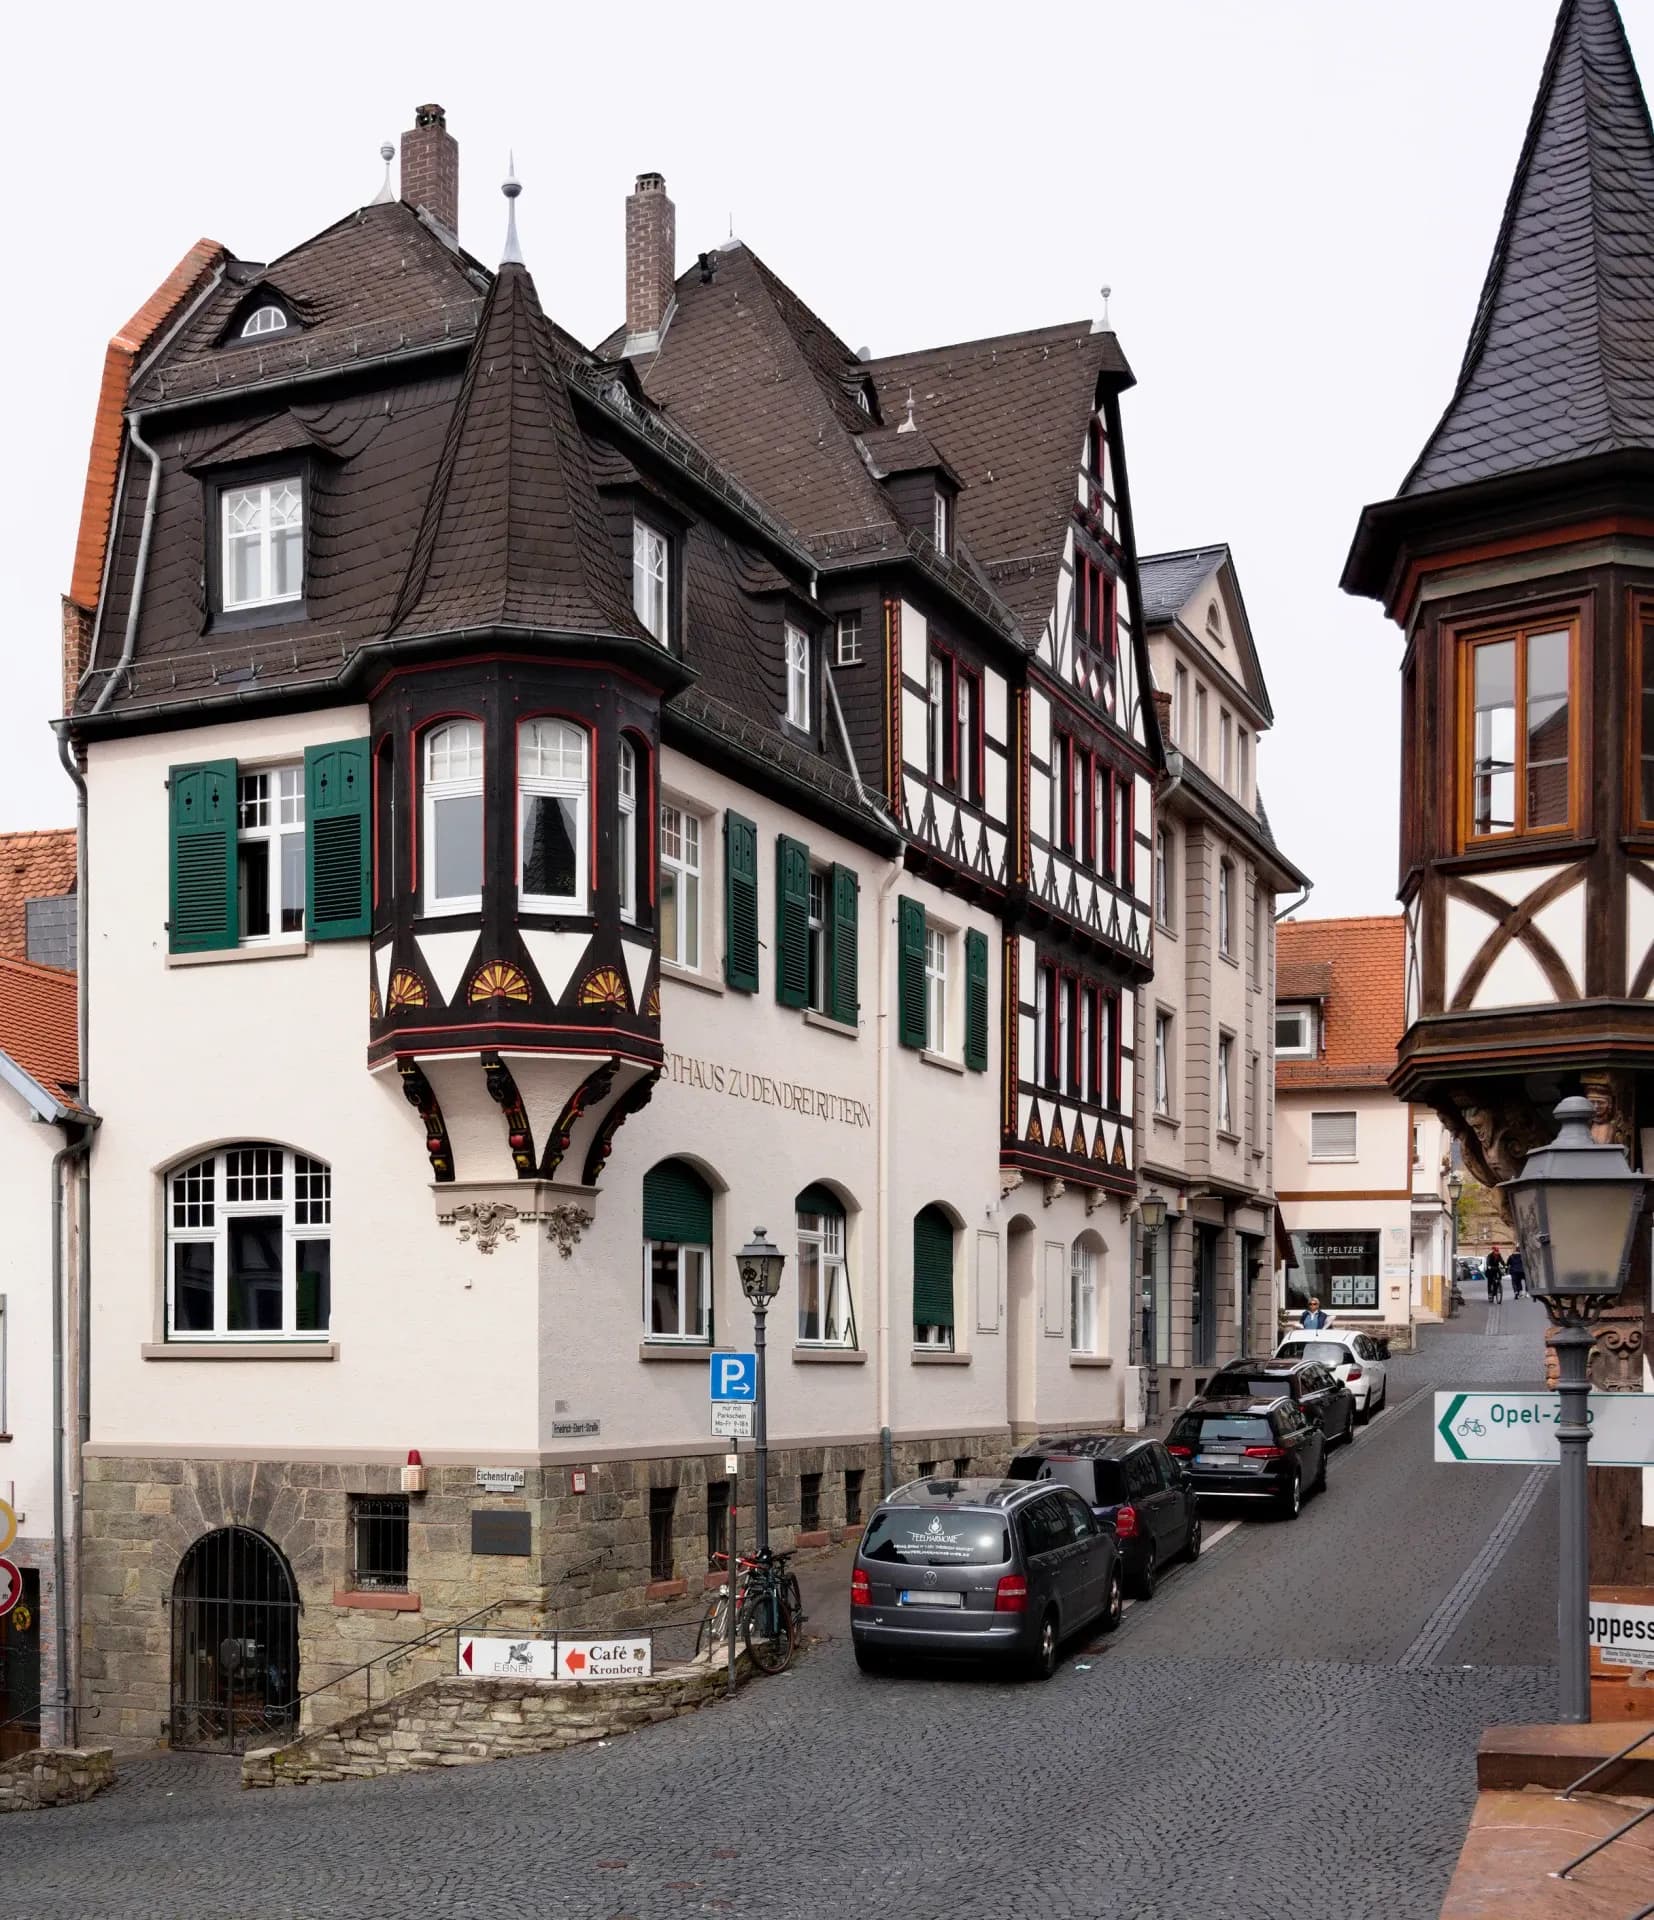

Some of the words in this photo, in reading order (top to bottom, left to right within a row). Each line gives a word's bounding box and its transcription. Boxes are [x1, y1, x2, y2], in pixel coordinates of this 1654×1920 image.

[660, 1051, 725, 1093] STHAUS
[728, 1069, 750, 1099] ZU
[751, 1074, 782, 1106] DEN
[783, 1082, 815, 1116] DREI
[816, 1091, 871, 1128] RITTERN
[1327, 1246, 1364, 1254] PELTZER
[721, 1359, 745, 1394] P
[1490, 1404, 1595, 1428] Opel-Zo
[476, 1469, 523, 1482] Eichenstraße
[1588, 1616, 1654, 1644] oppess
[589, 1646, 628, 1661] Café
[494, 1663, 533, 1673] EBNER
[589, 1665, 643, 1676] Kronberg
